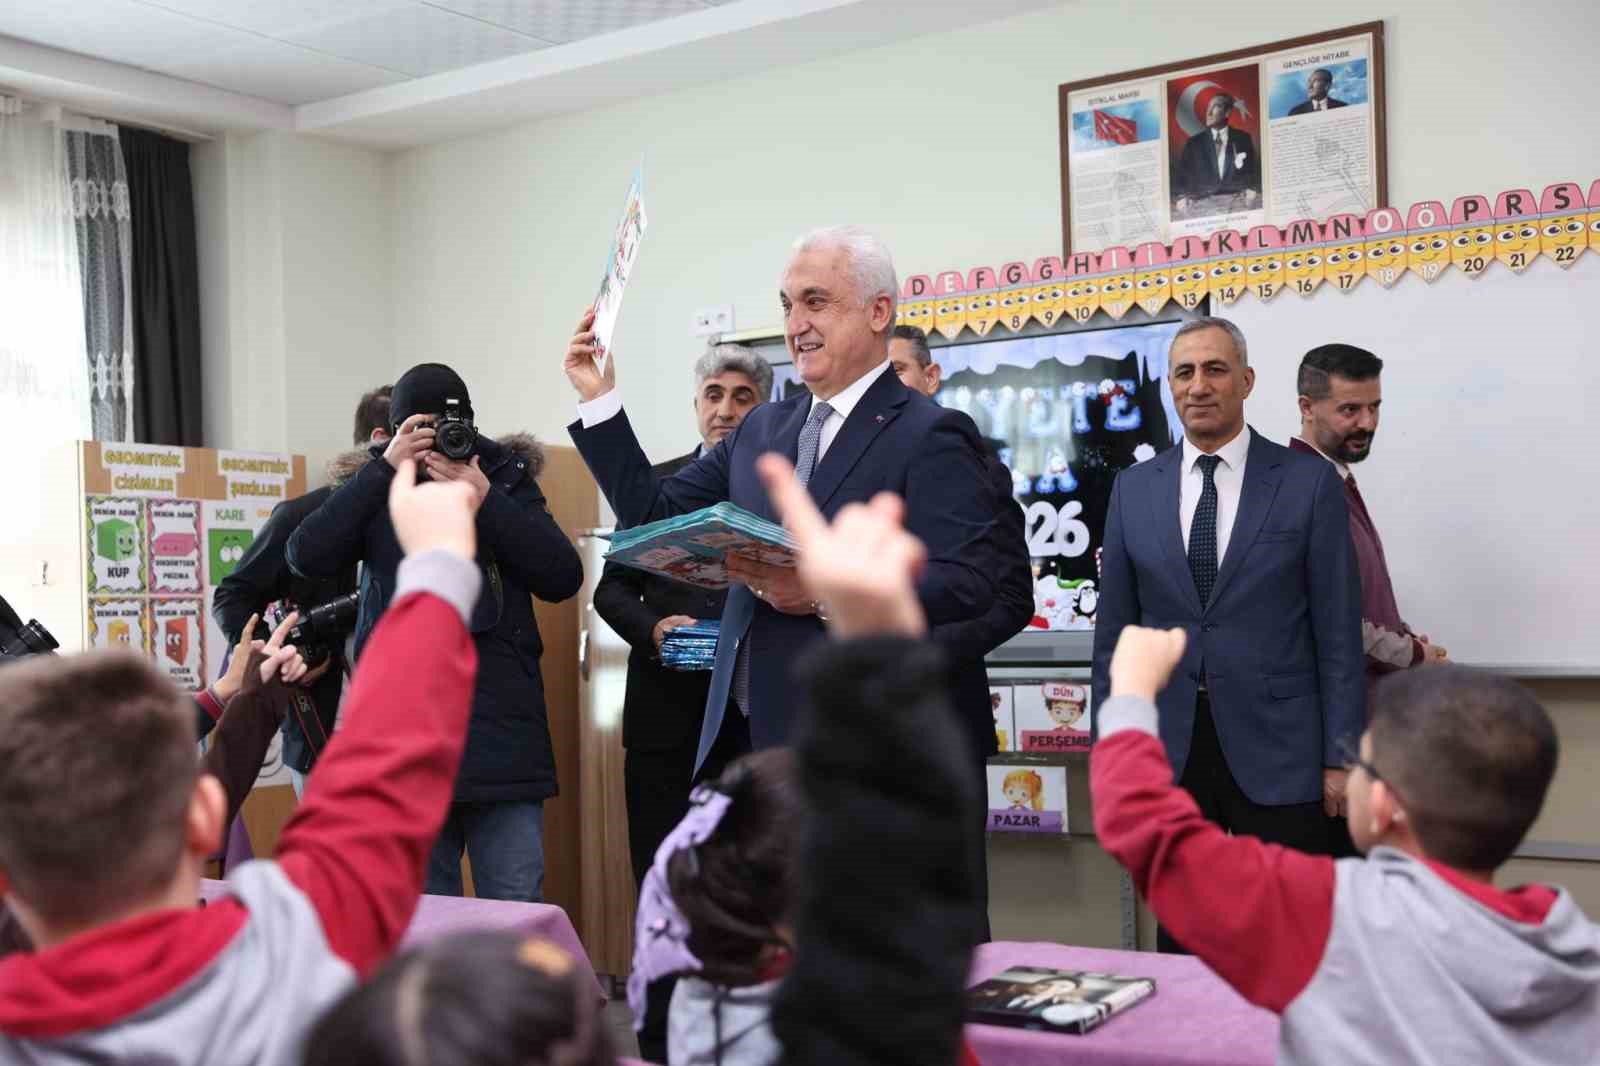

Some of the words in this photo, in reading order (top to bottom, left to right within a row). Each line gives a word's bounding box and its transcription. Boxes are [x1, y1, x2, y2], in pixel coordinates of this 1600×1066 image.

[912, 279, 924, 296] D
[944, 273, 955, 293] E
[976, 271, 985, 289] F
[1006, 265, 1022, 284] G
[1040, 258, 1053, 280] Ğ
[1074, 256, 1089, 275] H
[1182, 240, 1192, 260] J
[1218, 232, 1232, 251] K
[1258, 230, 1270, 248] L
[1292, 222, 1314, 244] M
[1333, 217, 1351, 239] N
[1372, 210, 1394, 232] O
[1417, 203, 1436, 228] Ö
[1463, 200, 1480, 221] P
[1506, 194, 1522, 216] R
[1553, 186, 1570, 210] S
[978, 320, 986, 332] 7
[1012, 315, 1020, 330] 8
[1044, 310, 1054, 324] 9
[1074, 306, 1090, 320] 10
[1183, 292, 1197, 307] 13
[1220, 288, 1236, 302] 14
[1258, 284, 1273, 298] 15
[1297, 279, 1313, 294] 16
[1338, 274, 1354, 290] 17
[1422, 263, 1439, 280] 19
[1463, 257, 1484, 273] 20
[1510, 252, 1526, 268] 21
[1555, 247, 1576, 262] 22
[216, 508, 246, 521] KARE
[1022, 500, 1090, 558] 26
[1029, 734, 1090, 749] PERŞEMB
[994, 814, 1041, 827] PAZAR
